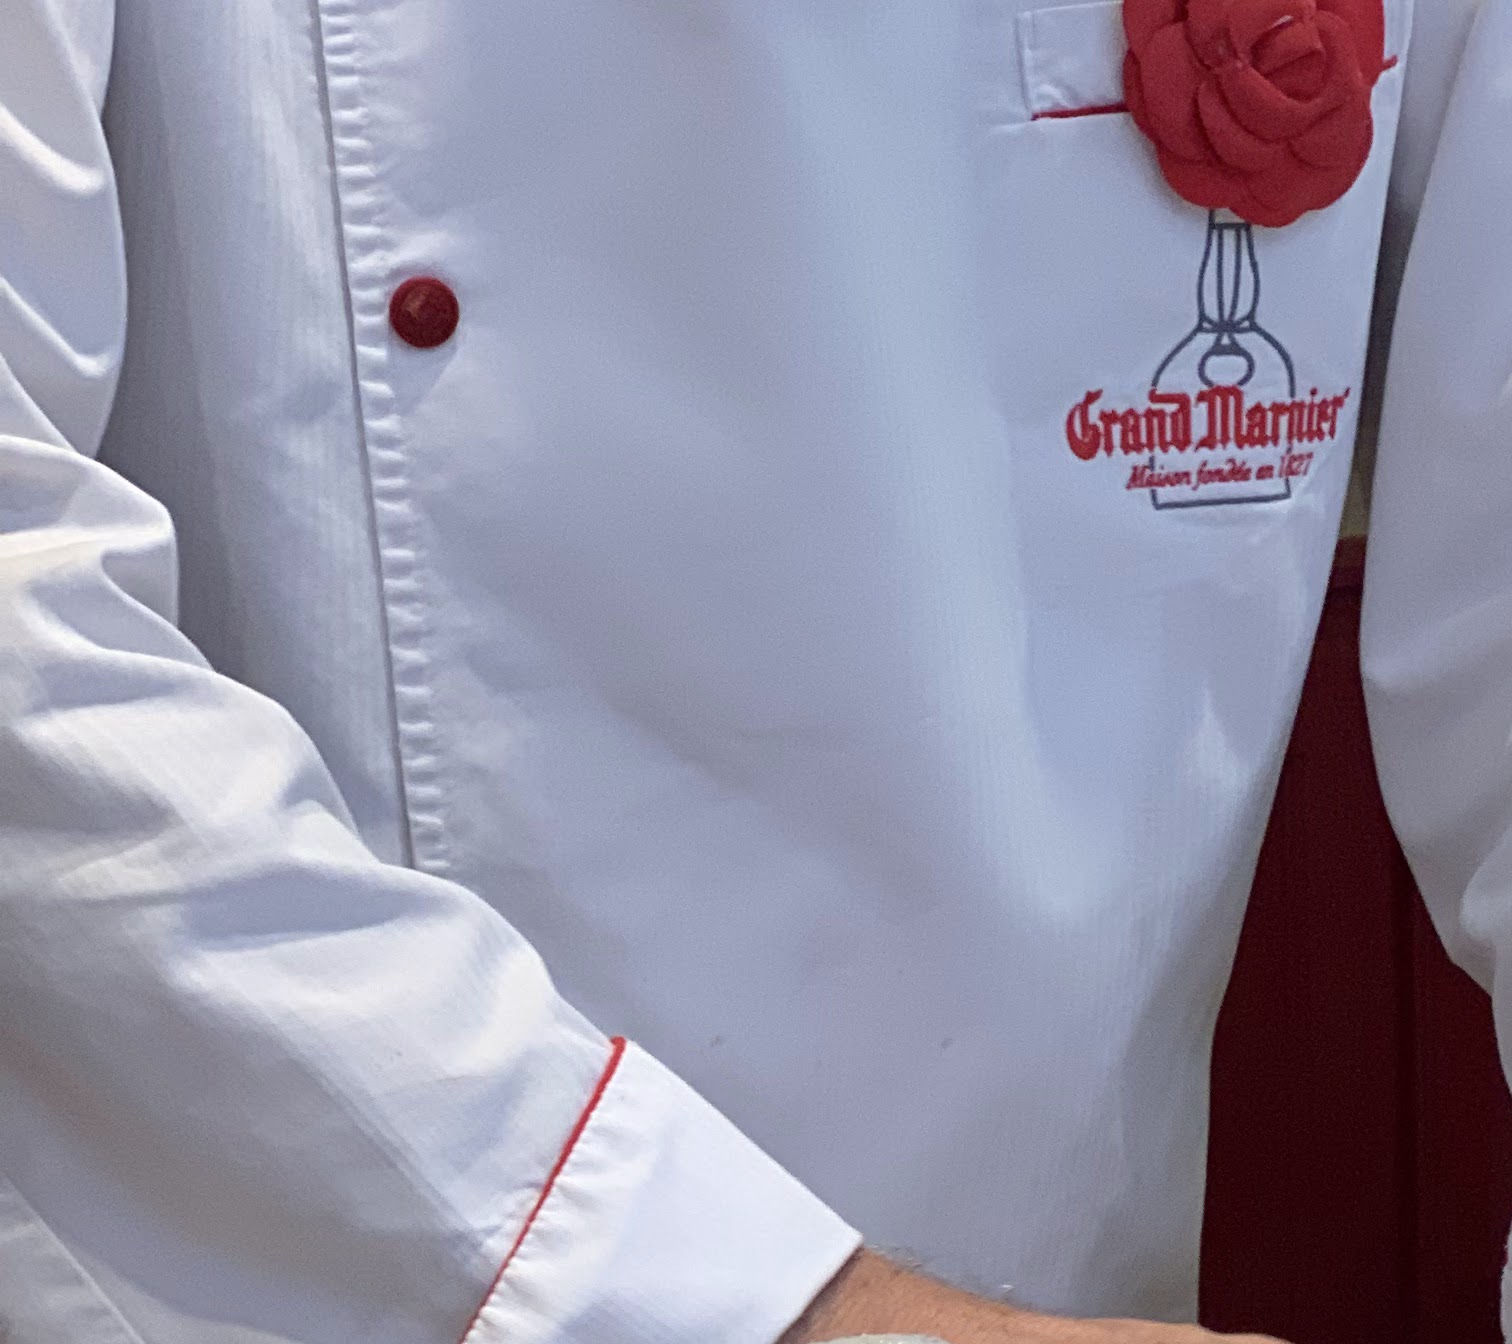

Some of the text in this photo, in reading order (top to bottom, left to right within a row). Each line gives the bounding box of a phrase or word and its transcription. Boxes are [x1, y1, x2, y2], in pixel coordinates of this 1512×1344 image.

[1066, 384, 1351, 460] Grand Marnier
[1126, 463, 1192, 490] Maison
[1256, 464, 1275, 481] en
